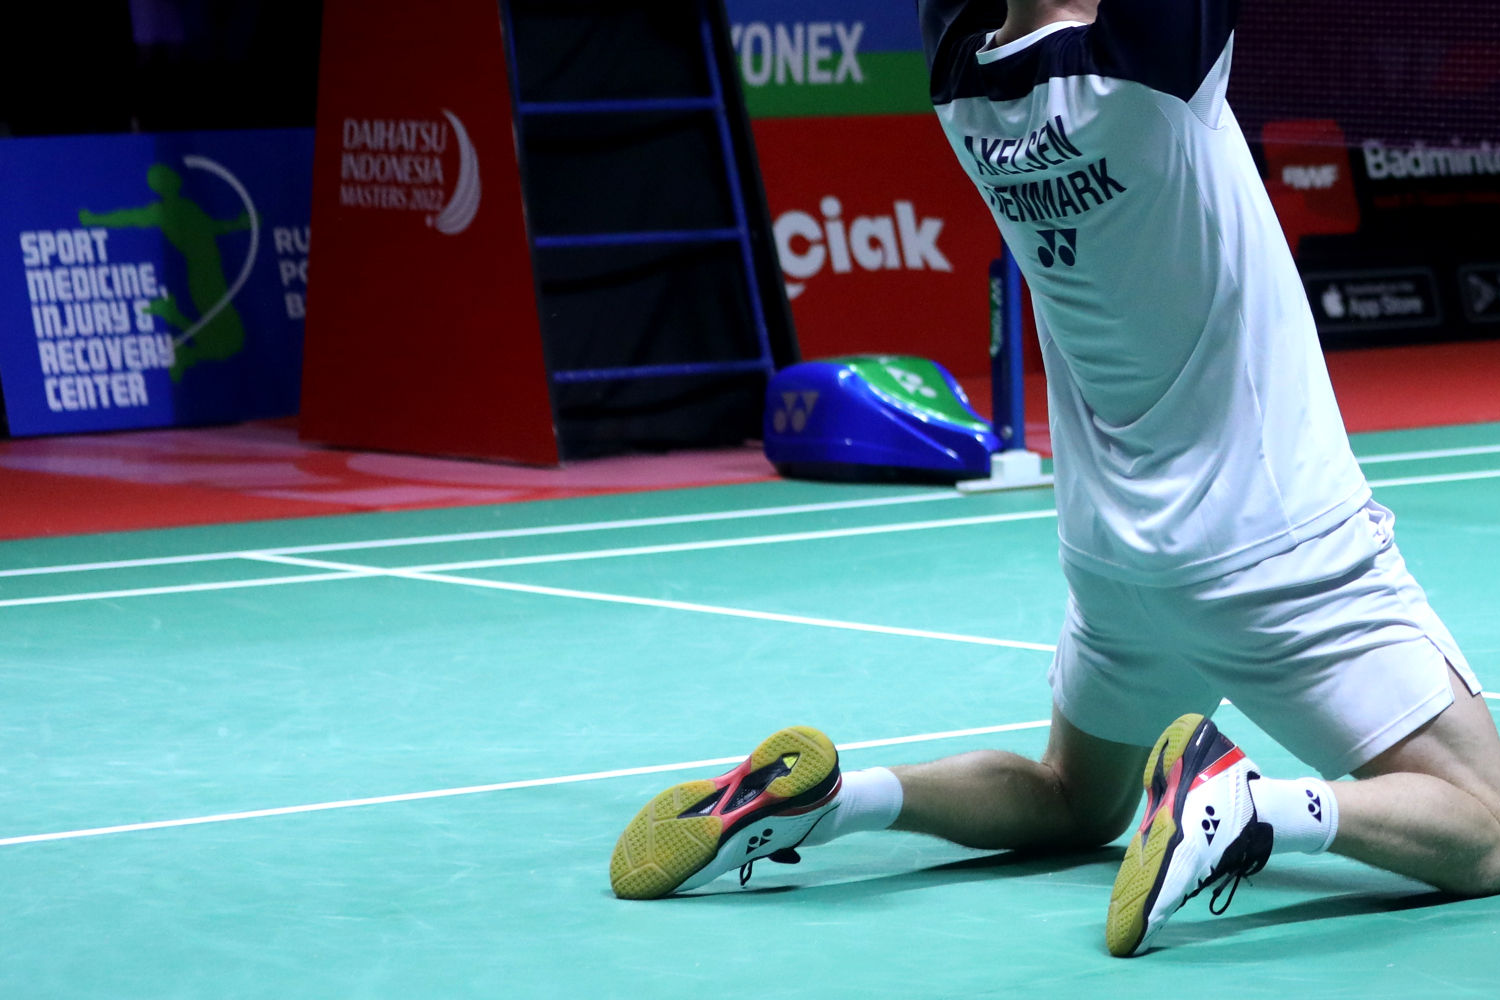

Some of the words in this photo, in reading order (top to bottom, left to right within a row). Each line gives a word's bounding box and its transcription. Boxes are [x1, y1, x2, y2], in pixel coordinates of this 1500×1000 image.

[342, 116, 449, 153] DAIHATSU
[340, 151, 445, 185] INDONESIA
[338, 183, 407, 211] MASTERS
[19, 227, 109, 267] SPORT
[30, 300, 131, 340] INJURY
[37, 333, 176, 376] RECOVERY
[44, 371, 149, 413] CENTER
